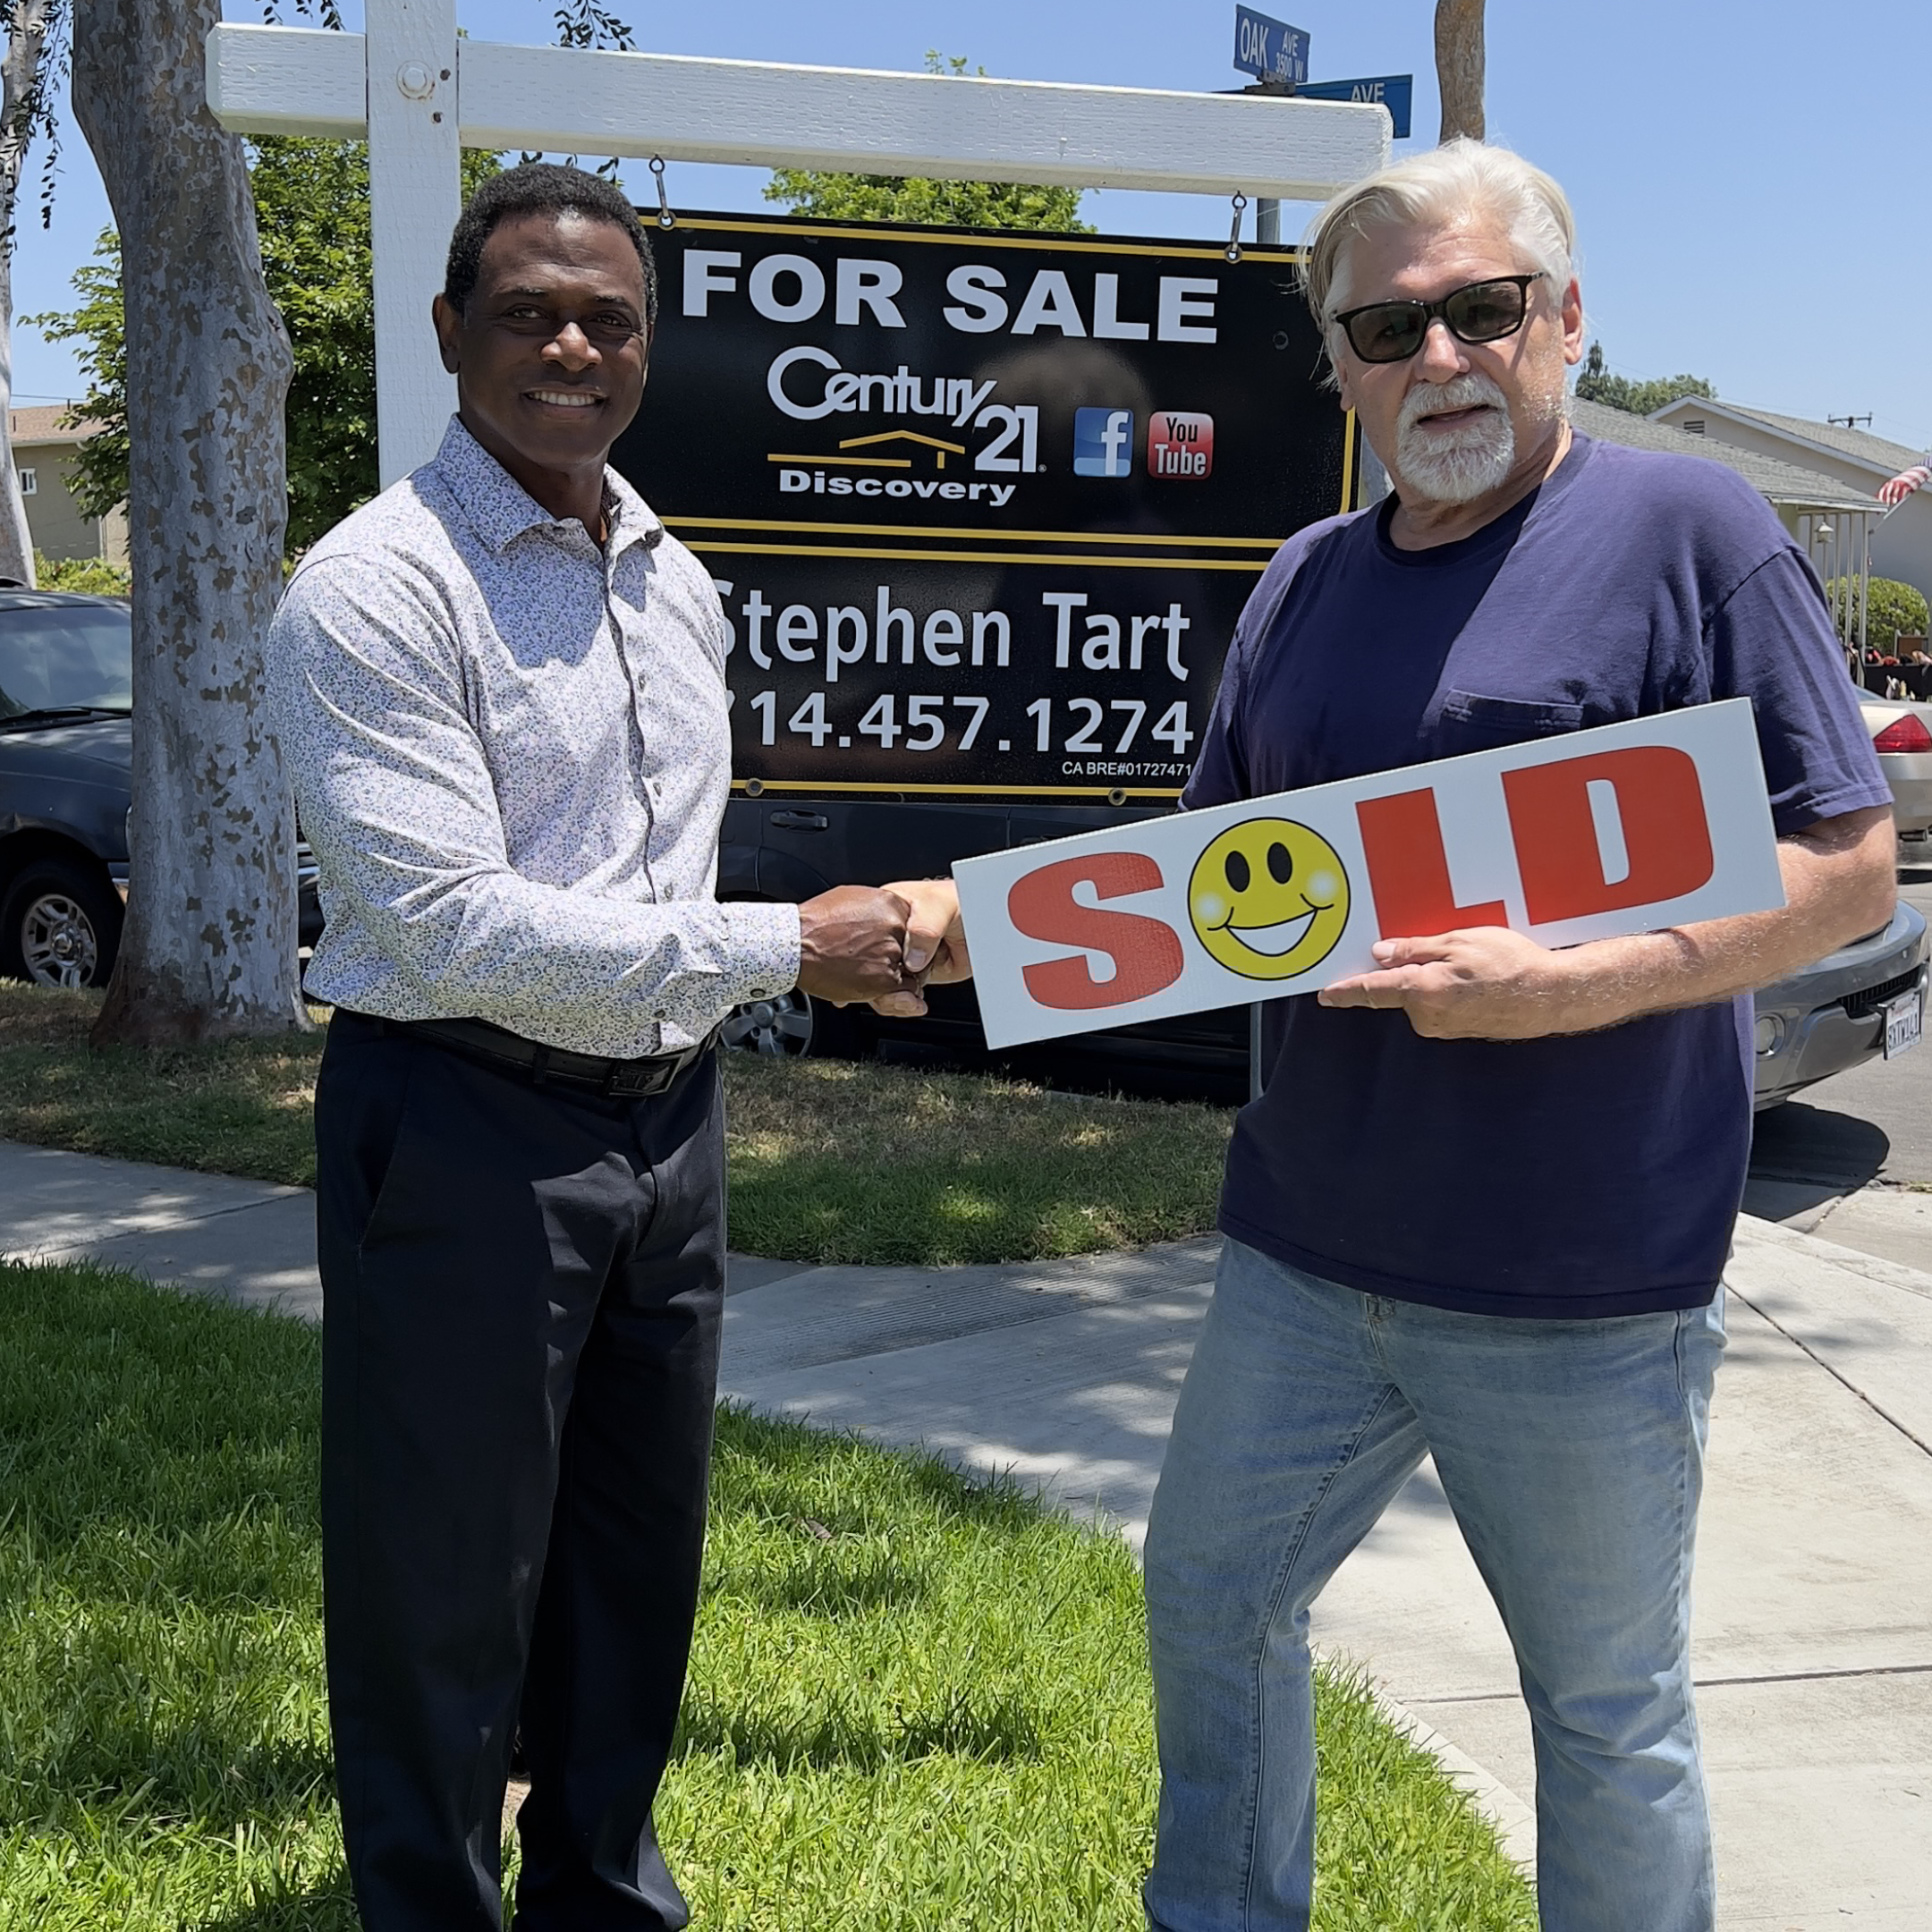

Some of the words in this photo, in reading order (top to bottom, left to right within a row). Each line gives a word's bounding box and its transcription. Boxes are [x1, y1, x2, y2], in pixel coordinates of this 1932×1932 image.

[1240, 18, 1269, 69] OAK
[1282, 30, 1299, 57] AVE
[1294, 59, 1304, 81] W
[1351, 82, 1385, 104] AVE
[683, 249, 907, 328] FOR
[944, 265, 1218, 343] SALE
[767, 345, 998, 428] Century
[1166, 417, 1199, 443] You
[1155, 444, 1208, 476] Tube
[779, 469, 1016, 506] Discovery
[1042, 592, 1191, 682] Tart
[725, 689, 1194, 754] 14.457.1274
[1062, 761, 1084, 775] CA
[1086, 761, 1192, 776] BRE#01727471
